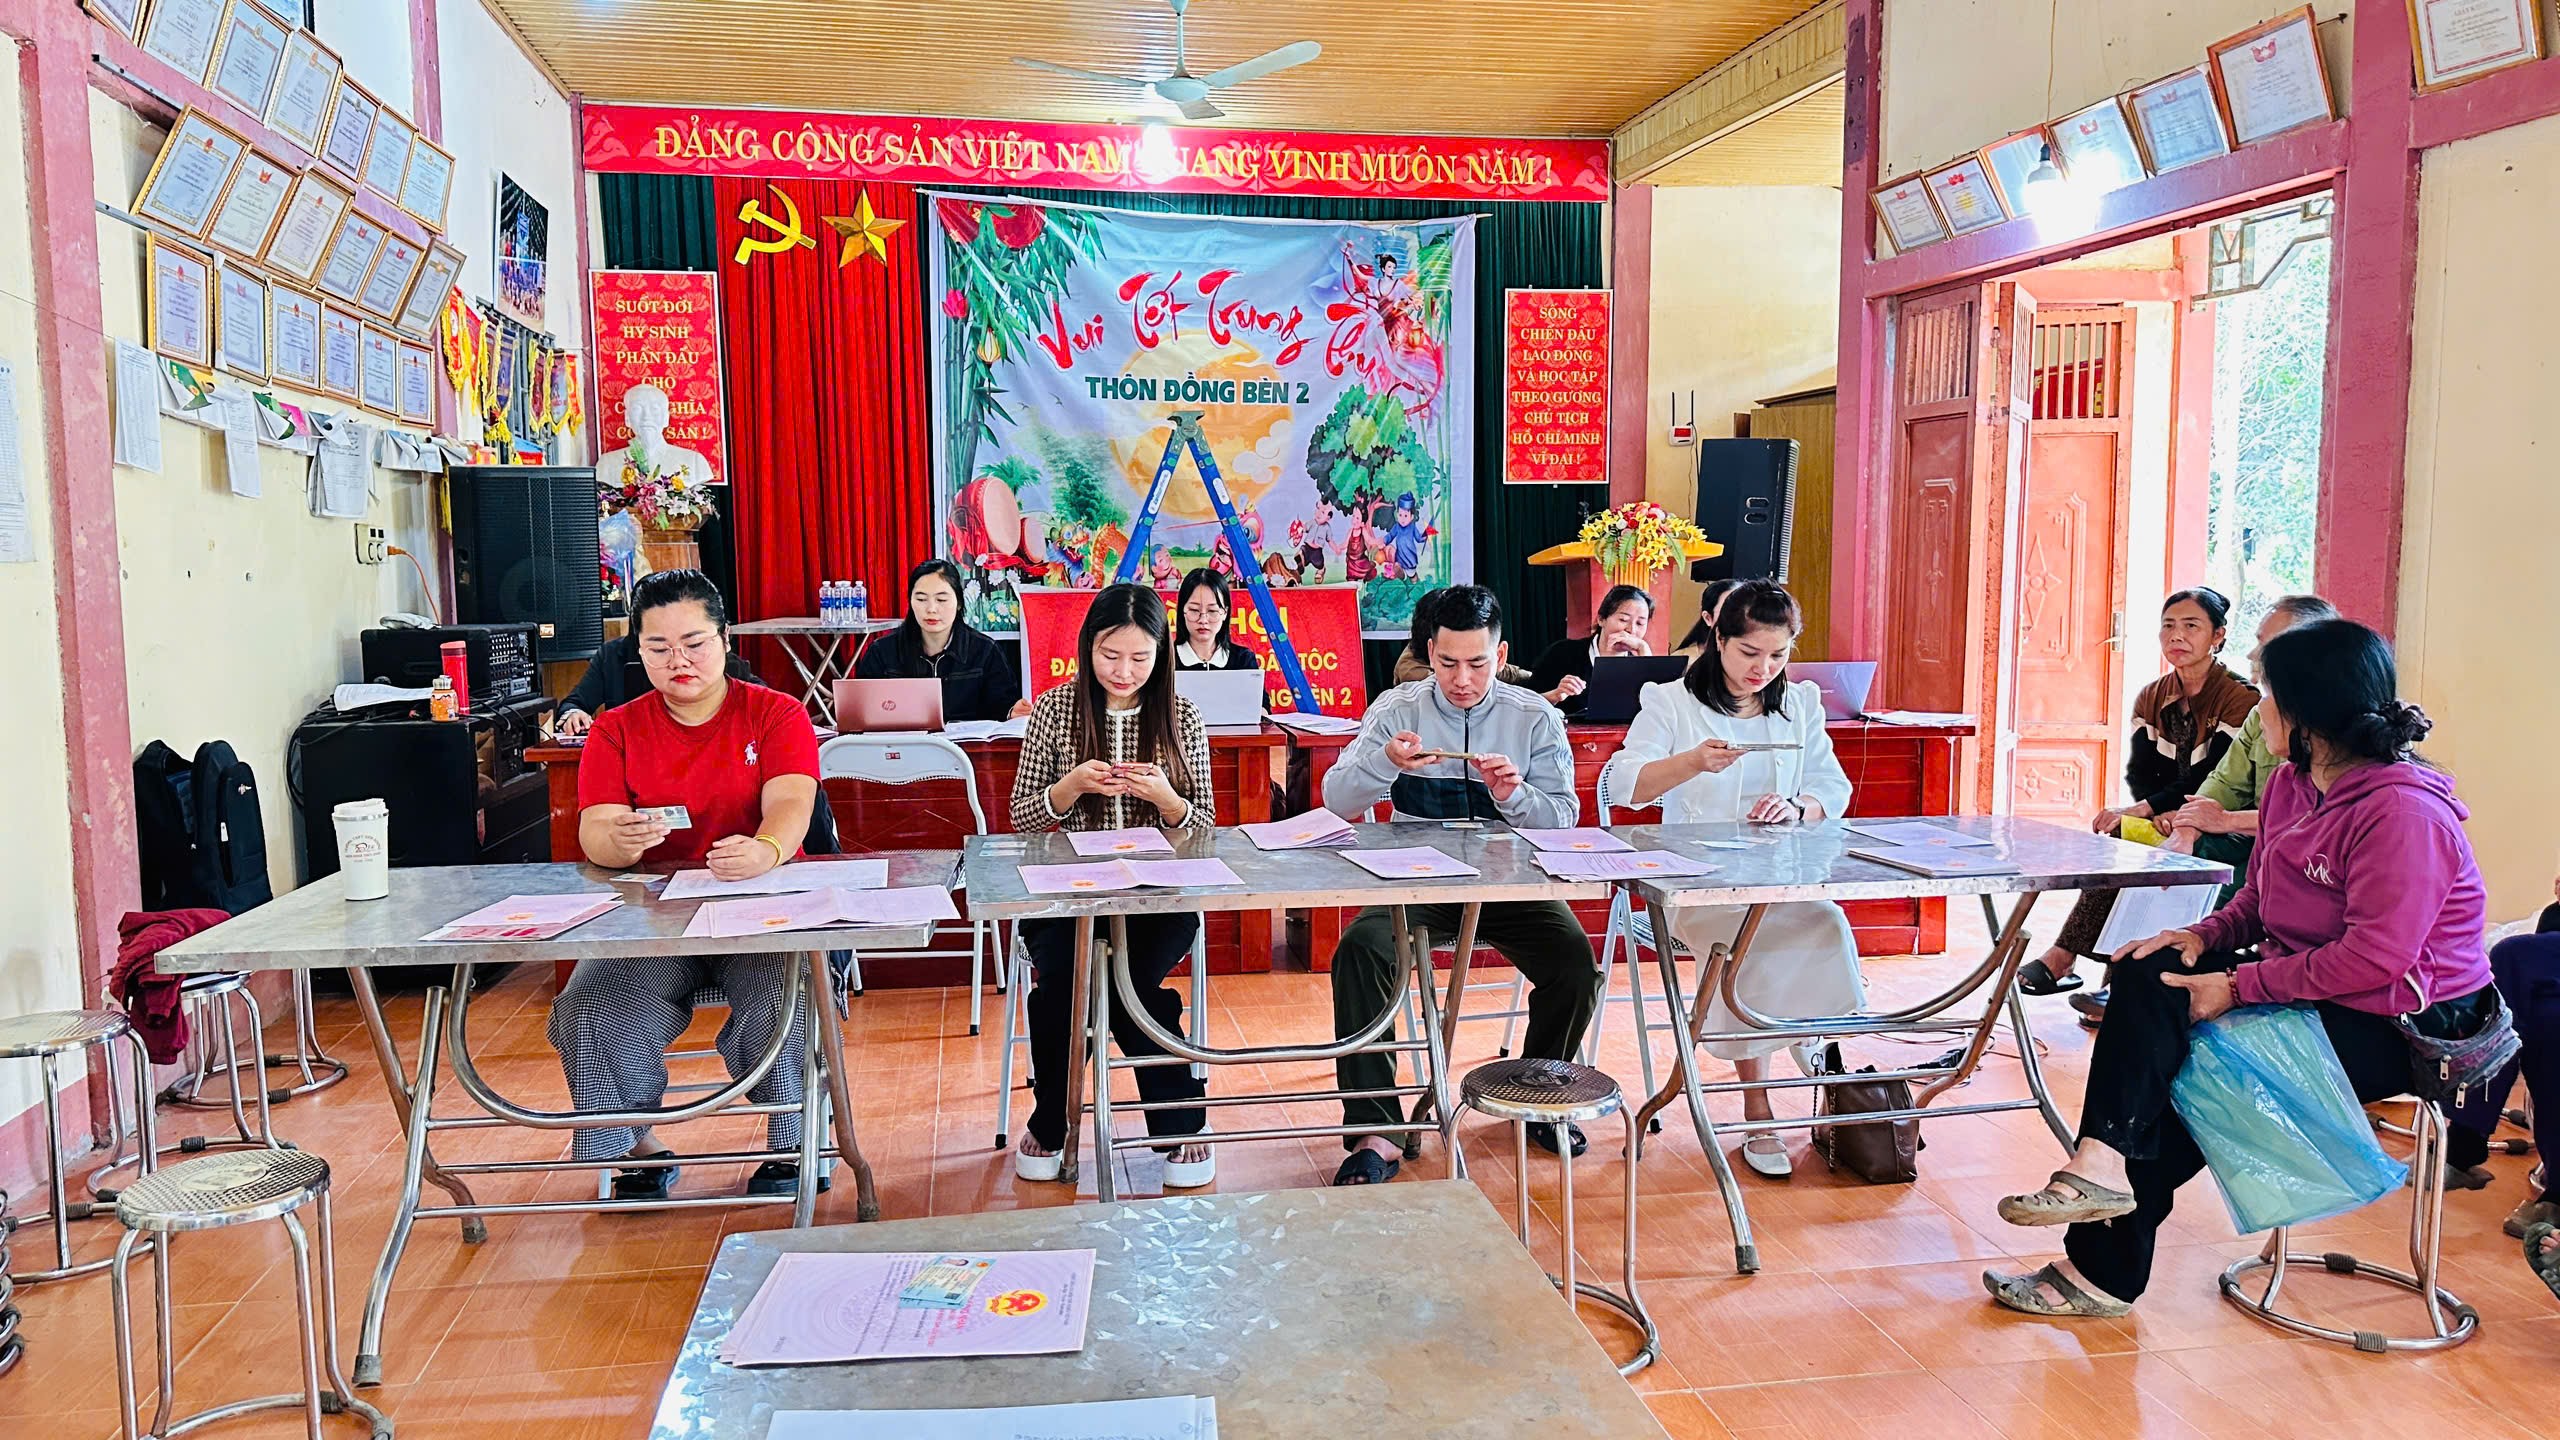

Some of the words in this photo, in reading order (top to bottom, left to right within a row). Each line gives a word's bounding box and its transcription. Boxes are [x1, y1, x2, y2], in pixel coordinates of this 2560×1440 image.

[655, 115, 761, 160] ĐẢNG
[771, 121, 875, 173] CỘNG
[885, 124, 953, 167] SẢN
[963, 131, 1045, 179] VIỆT
[1056, 141, 1131, 175] NAM
[1174, 146, 1261, 180] ANG
[1268, 148, 1350, 182] VINH
[1360, 148, 1459, 184] MUÔN
[1466, 147, 1538, 186] NĂM
[1545, 158, 1553, 186] !
[615, 295, 660, 313] SUỐT
[663, 296, 694, 314] ĐỜI
[1539, 303, 1577, 319] SỐNG
[1037, 298, 1104, 369] Vui
[1119, 270, 1193, 349] Tết
[1198, 268, 1319, 365] Trung
[623, 326, 645, 339] HY
[649, 326, 689, 339] SINH
[1520, 324, 1565, 340] CHIẾN
[1567, 325, 1597, 340] ĐẤU
[665, 346, 700, 364] ĐẤU
[1523, 349, 1550, 361] LAO
[1553, 347, 1593, 364] ĐỘNG
[1517, 367, 1536, 382] VÀ
[1539, 370, 1568, 384] HỌC
[1570, 367, 1598, 385] TẬP
[1085, 373, 1157, 401] THÔN
[1164, 372, 1235, 403] ĐỒNG
[1242, 377, 1289, 403] BÈN
[1296, 382, 1310, 404] 2
[1511, 391, 1550, 403] THEO
[1553, 389, 1601, 403] GƯƠNG
[668, 399, 706, 415] GHĨA
[1524, 408, 1553, 424] CHỦ
[1557, 412, 1589, 426] TỊCH
[666, 422, 698, 439] SẢN
[1536, 430, 1561, 444] CHÍ
[1564, 432, 1600, 444] MINH
[1532, 451, 1546, 465] VĨ
[1298, 647, 1339, 676] TỘC
[1340, 686, 1353, 706] 2
